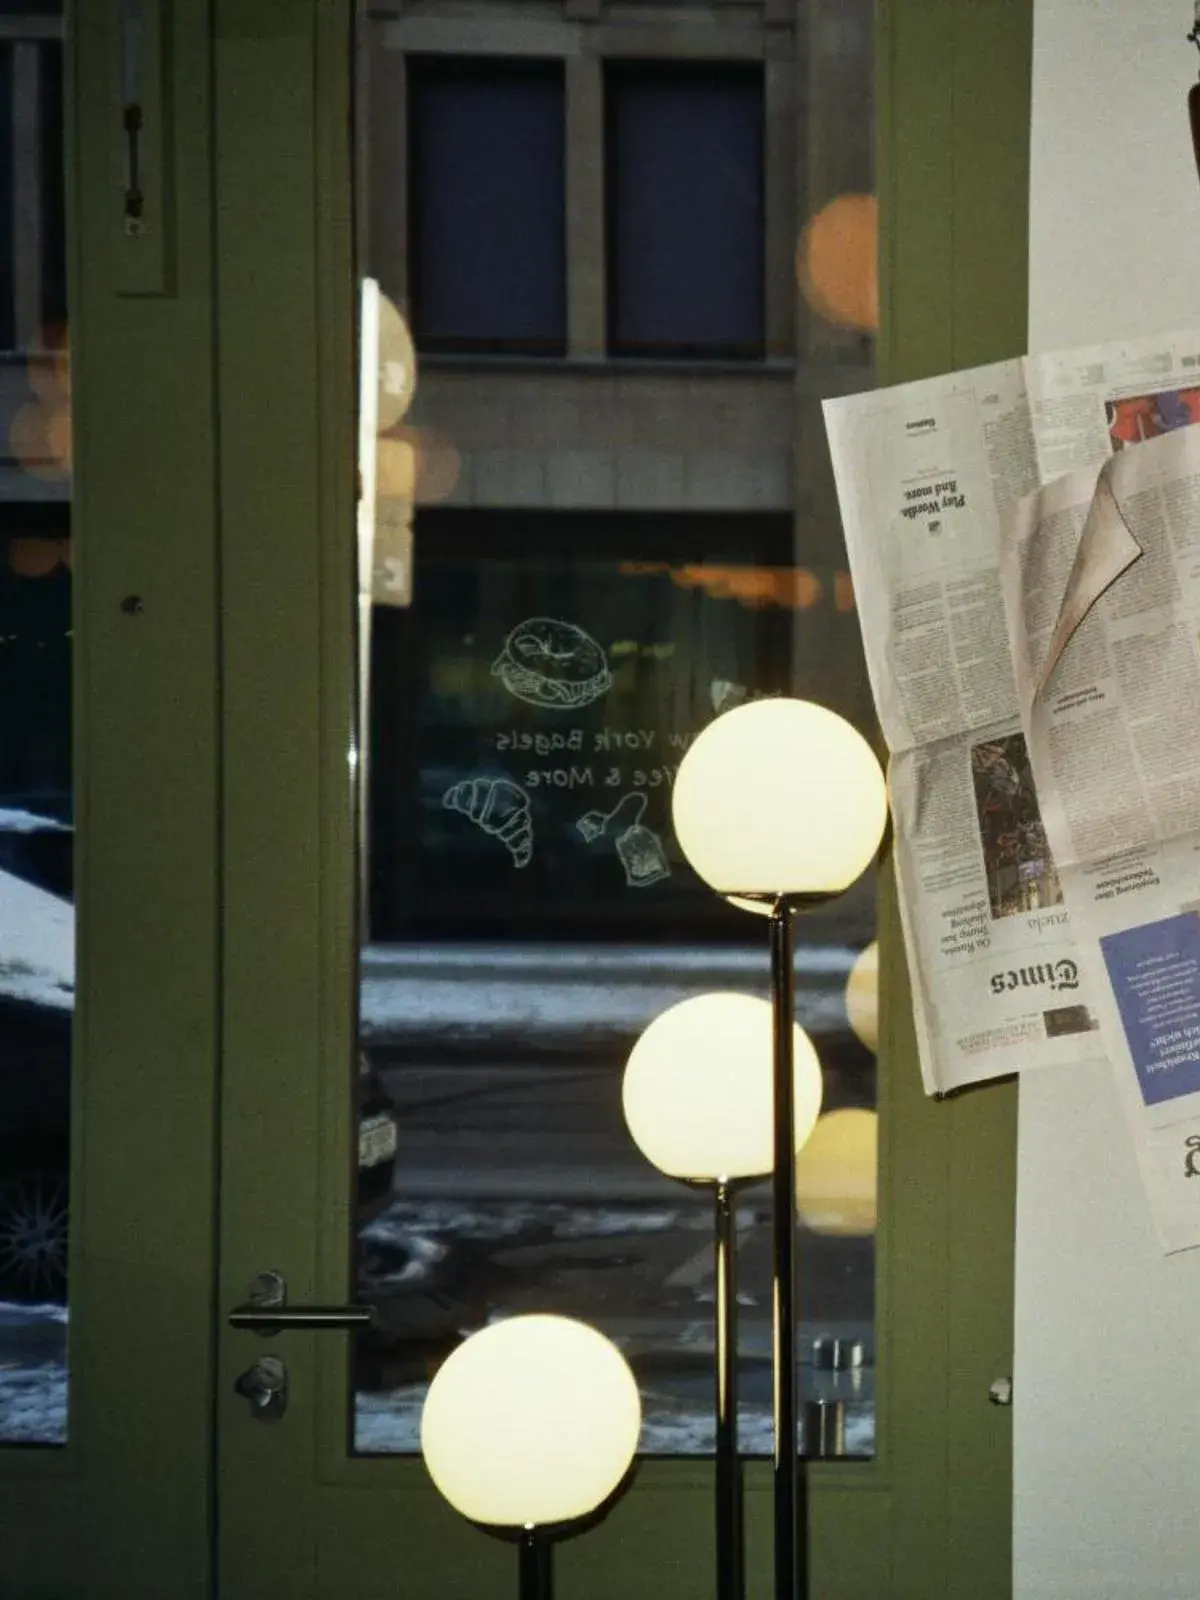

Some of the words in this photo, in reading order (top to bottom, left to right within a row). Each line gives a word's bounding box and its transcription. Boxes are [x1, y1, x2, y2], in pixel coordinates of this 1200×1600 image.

[934, 480, 957, 497] And
[942, 493, 965, 510] Play
[990, 959, 1079, 995] Times
